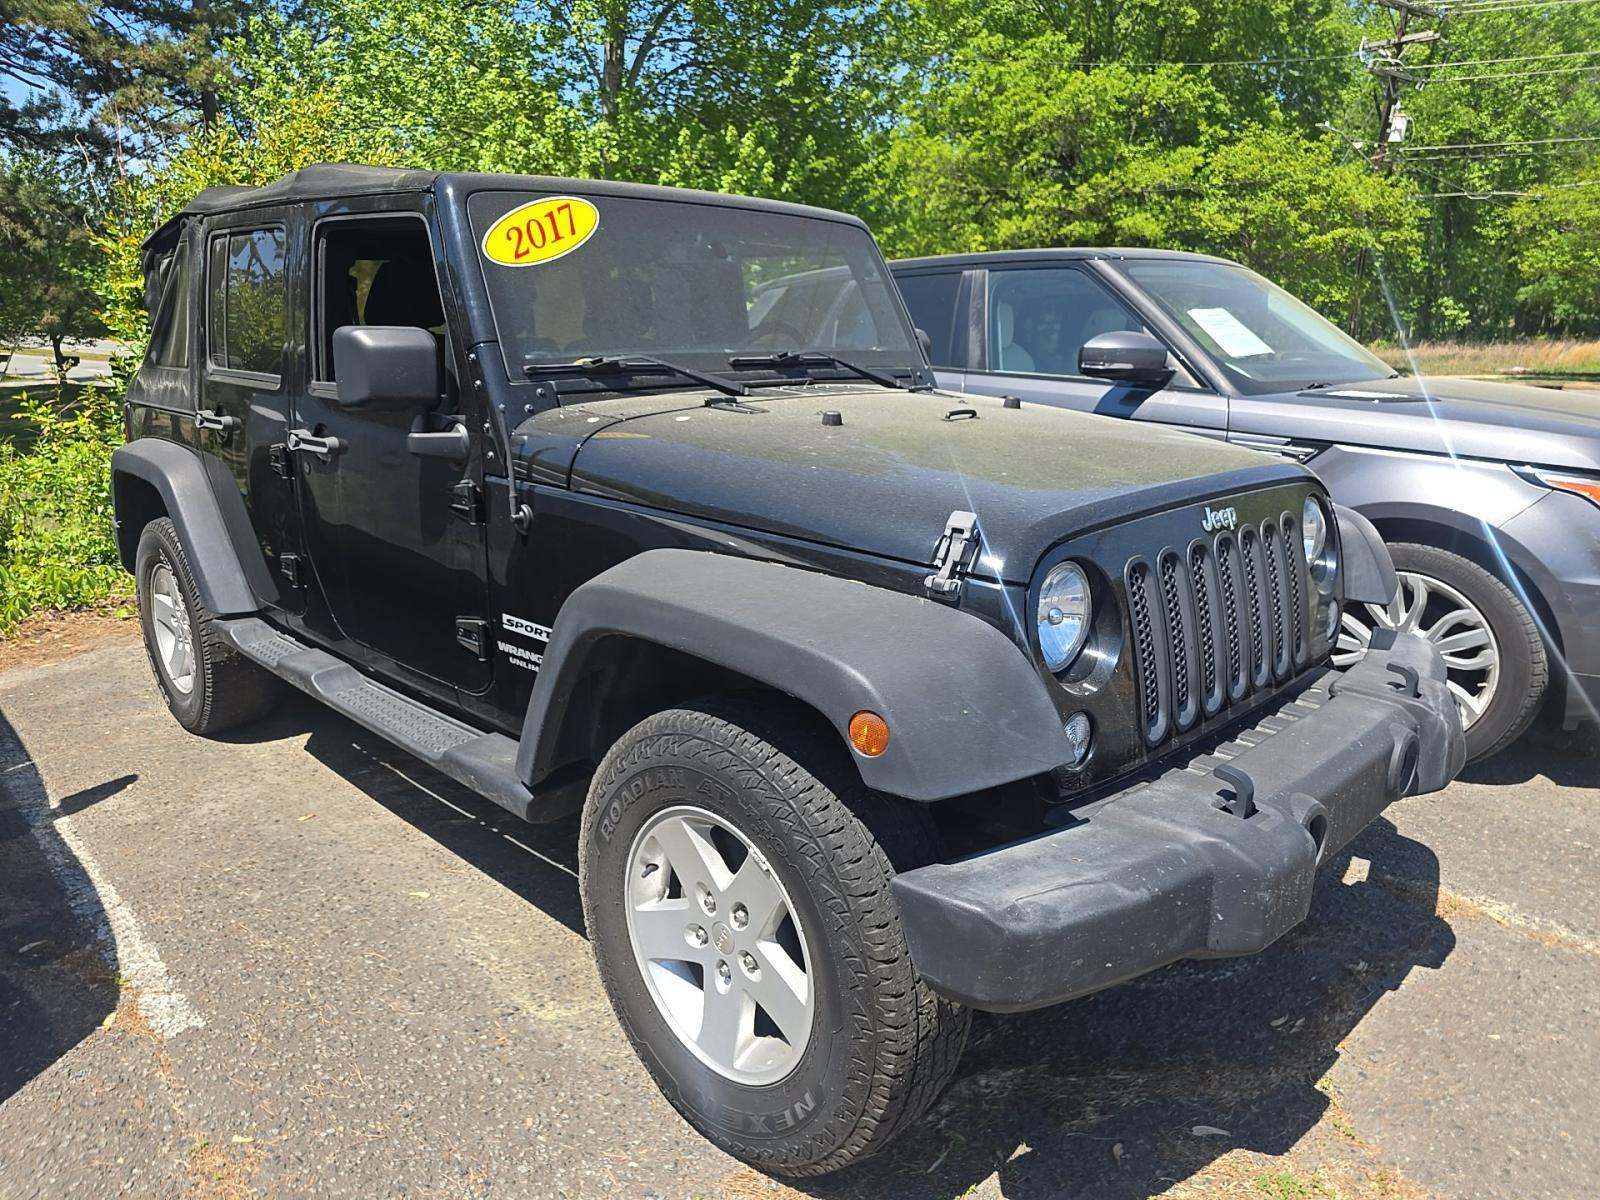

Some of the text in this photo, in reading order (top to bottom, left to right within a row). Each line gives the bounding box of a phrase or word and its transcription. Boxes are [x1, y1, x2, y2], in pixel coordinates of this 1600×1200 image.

[506, 202, 576, 260] 2017
[1202, 506, 1237, 532] Jeep
[503, 618, 552, 639] SPORT
